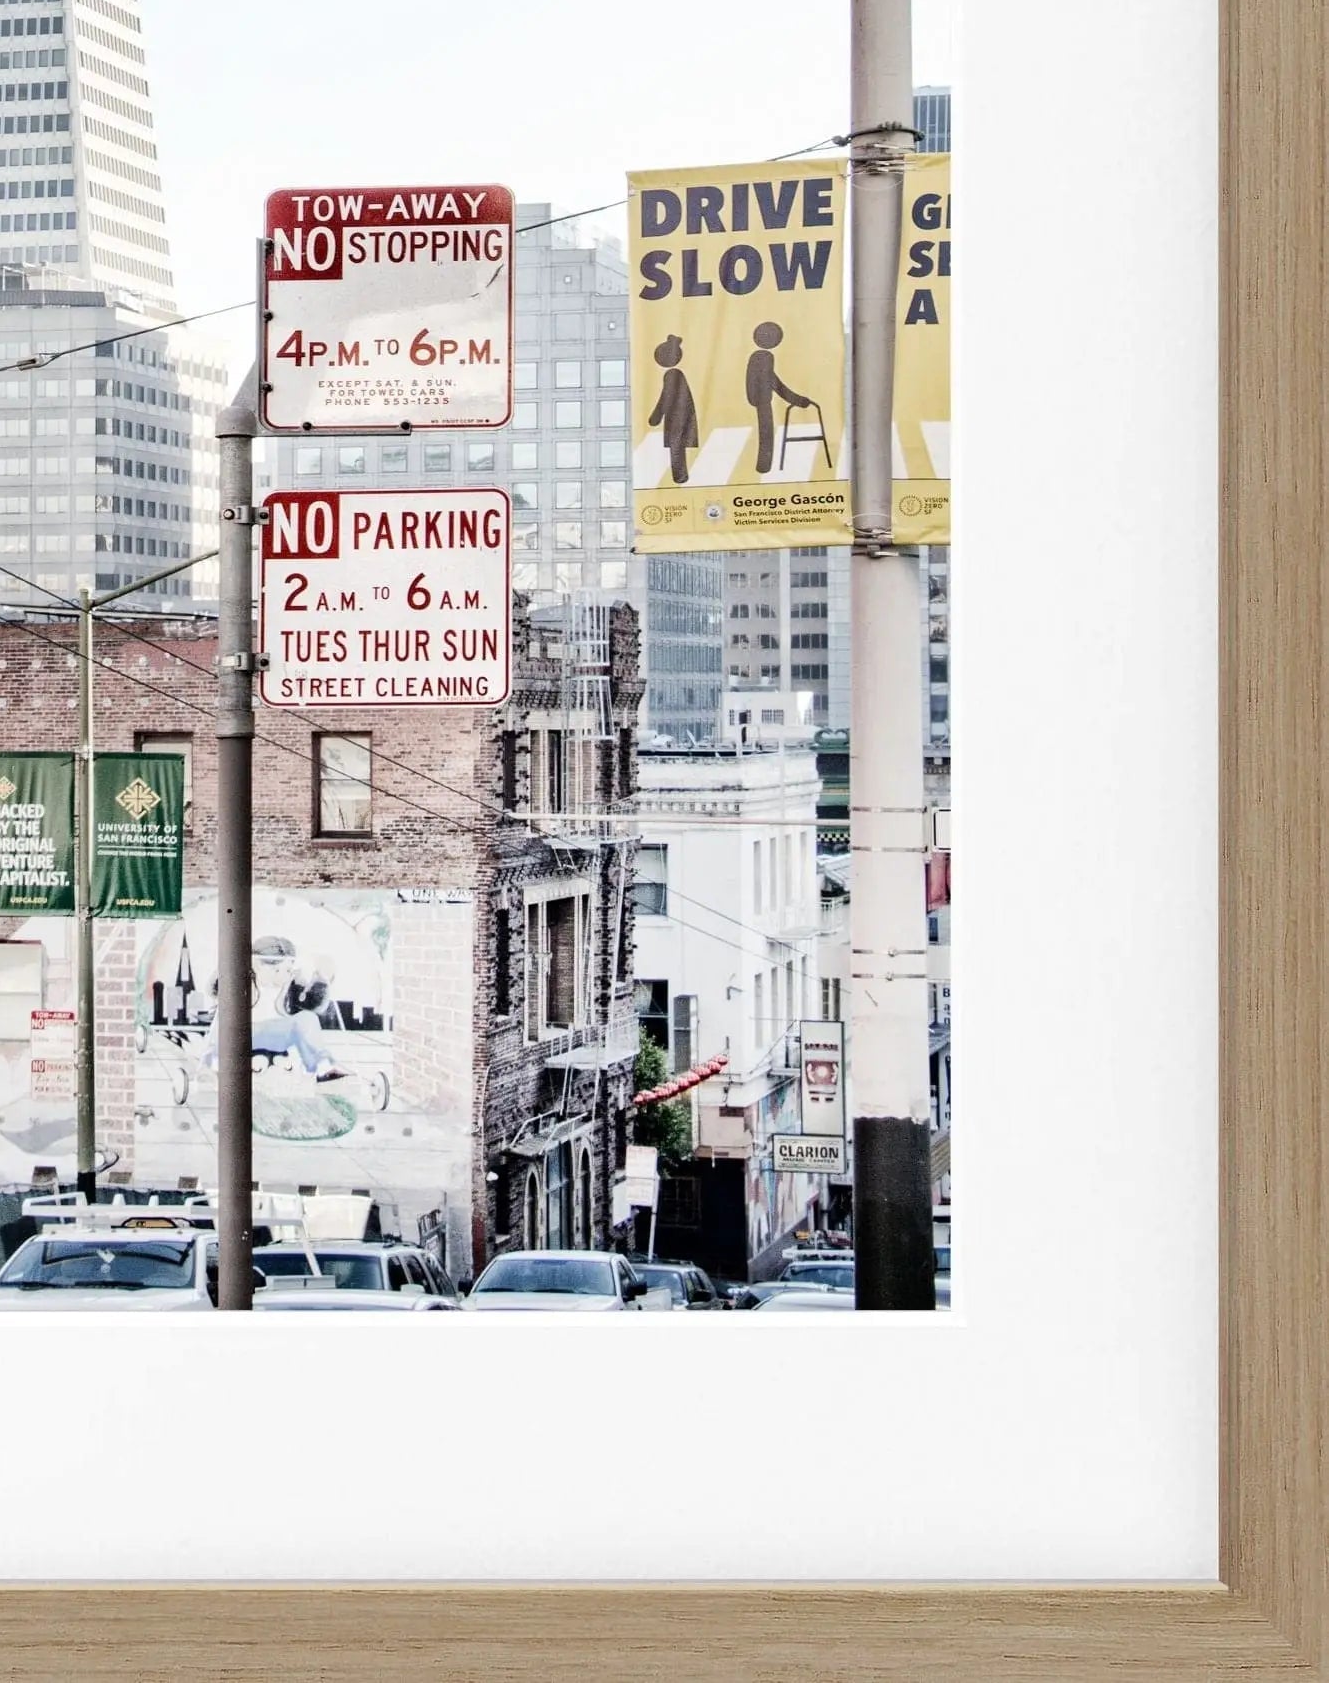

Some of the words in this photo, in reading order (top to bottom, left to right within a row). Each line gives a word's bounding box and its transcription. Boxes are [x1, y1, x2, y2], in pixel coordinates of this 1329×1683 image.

[292, 192, 487, 222] TOW-AWAY
[640, 178, 834, 238] DRIVE
[273, 226, 336, 271] NO
[348, 229, 503, 263] STOPPING
[639, 240, 833, 301] SLOW
[904, 289, 939, 325] A
[374, 339, 399, 355] TO
[318, 380, 370, 388] EXCEPT
[411, 379, 419, 387] &
[426, 379, 457, 387] SUN.
[330, 389, 355, 397] FOR
[325, 398, 371, 406] PHONE
[383, 397, 450, 405] 553-1235
[733, 495, 786, 508] George
[791, 492, 844, 505] Gascón
[749, 509, 783, 517] Francisco
[784, 508, 810, 516] District
[272, 501, 334, 554] NO
[353, 509, 501, 550] PARKING
[734, 518, 757, 526] Victim
[758, 517, 789, 525] Services
[790, 516, 821, 524] Division
[284, 573, 308, 611] 2
[373, 586, 391, 600] TO
[406, 572, 431, 610] 6
[281, 630, 348, 662] TUES
[359, 630, 431, 662] THUR
[443, 629, 498, 661] SUN
[281, 677, 366, 697] STREET
[375, 676, 489, 697] CLEANING
[14, 821, 41, 836] THE
[97, 823, 161, 833] UNIVERSITY
[163, 824, 178, 834] OF
[97, 833, 119, 843] SAN
[121, 834, 178, 845] FRANCISCO
[9, 896, 48, 904] USFCA.EDU
[116, 898, 155, 906] USFCA.EDU
[31, 1019, 44, 1029] NO
[32, 1061, 45, 1072] NO
[779, 1145, 839, 1158] CLARION
